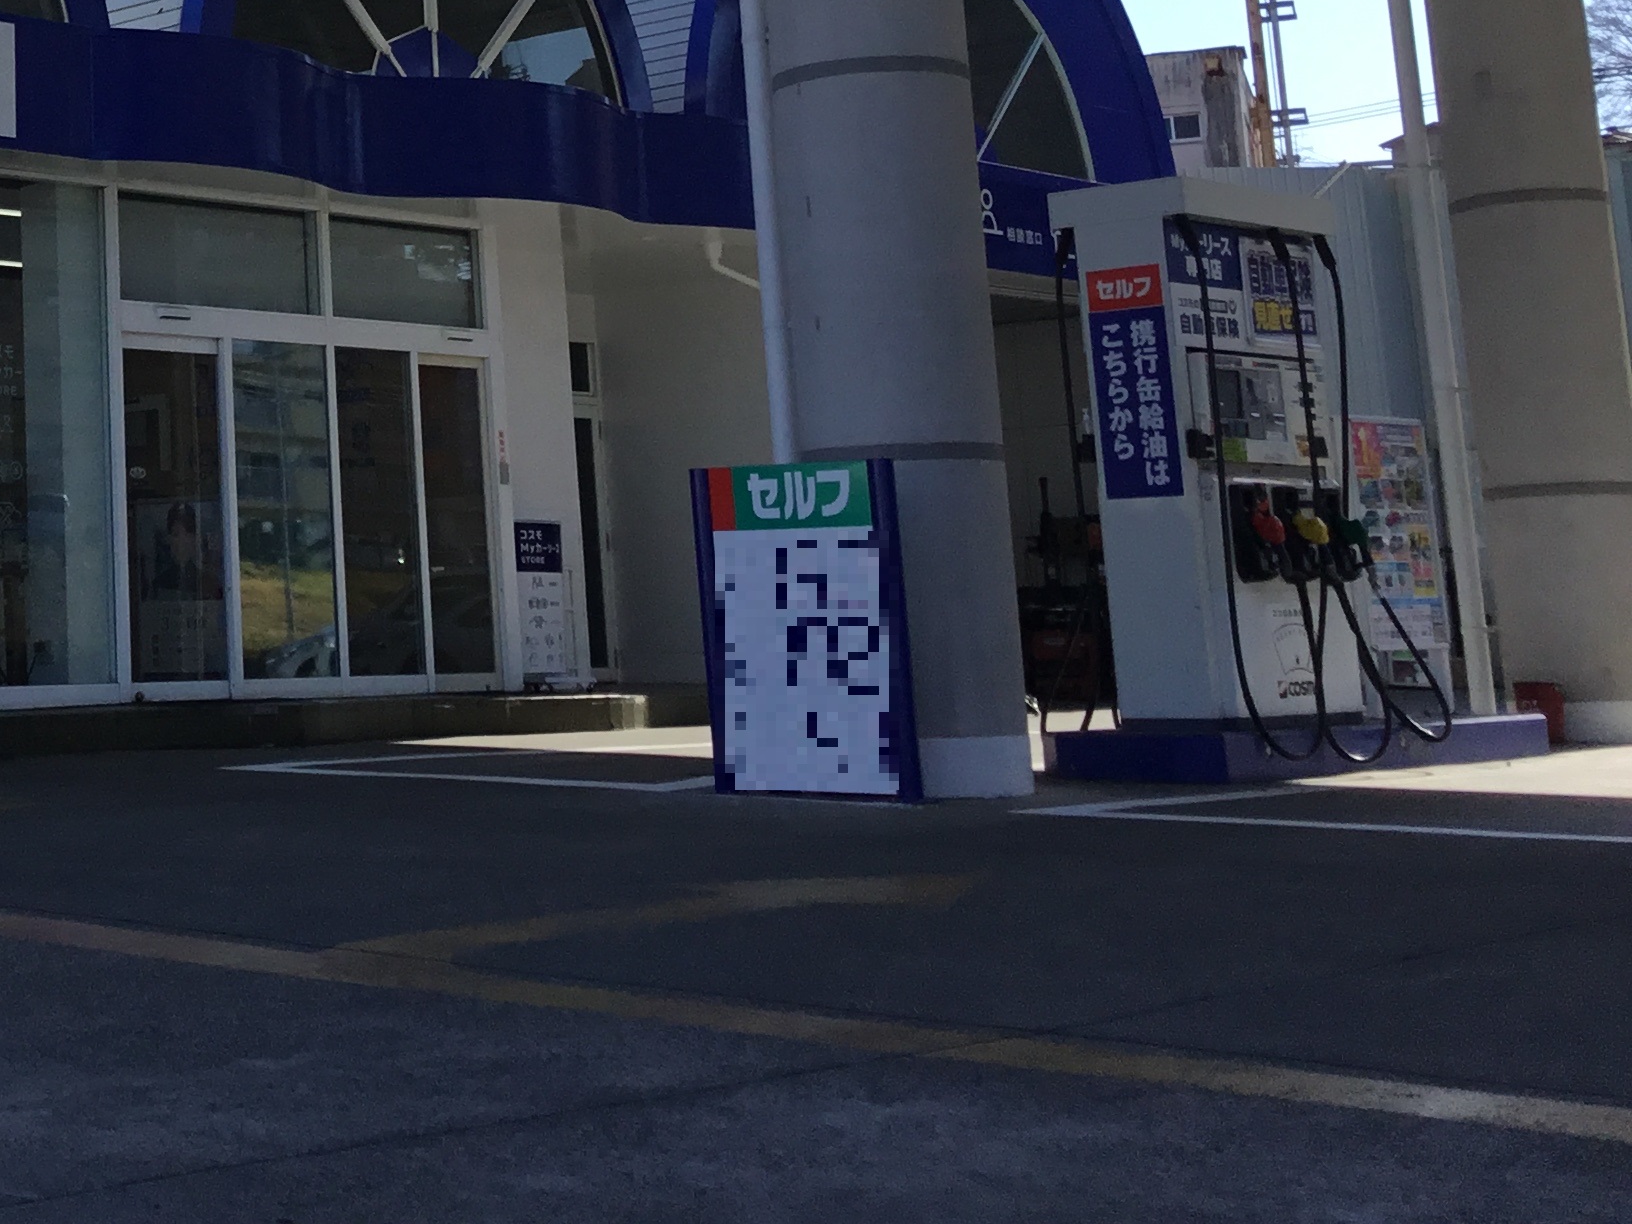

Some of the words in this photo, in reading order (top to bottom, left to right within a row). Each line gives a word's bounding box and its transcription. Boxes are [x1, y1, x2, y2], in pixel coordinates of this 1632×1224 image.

[1095, 276, 1152, 301] セルフ
[1101, 322, 1135, 461] こちらから
[1129, 319, 1171, 487] 携行缶給油は
[747, 469, 850, 520] セルフ
[1288, 681, 1316, 697] COSM
